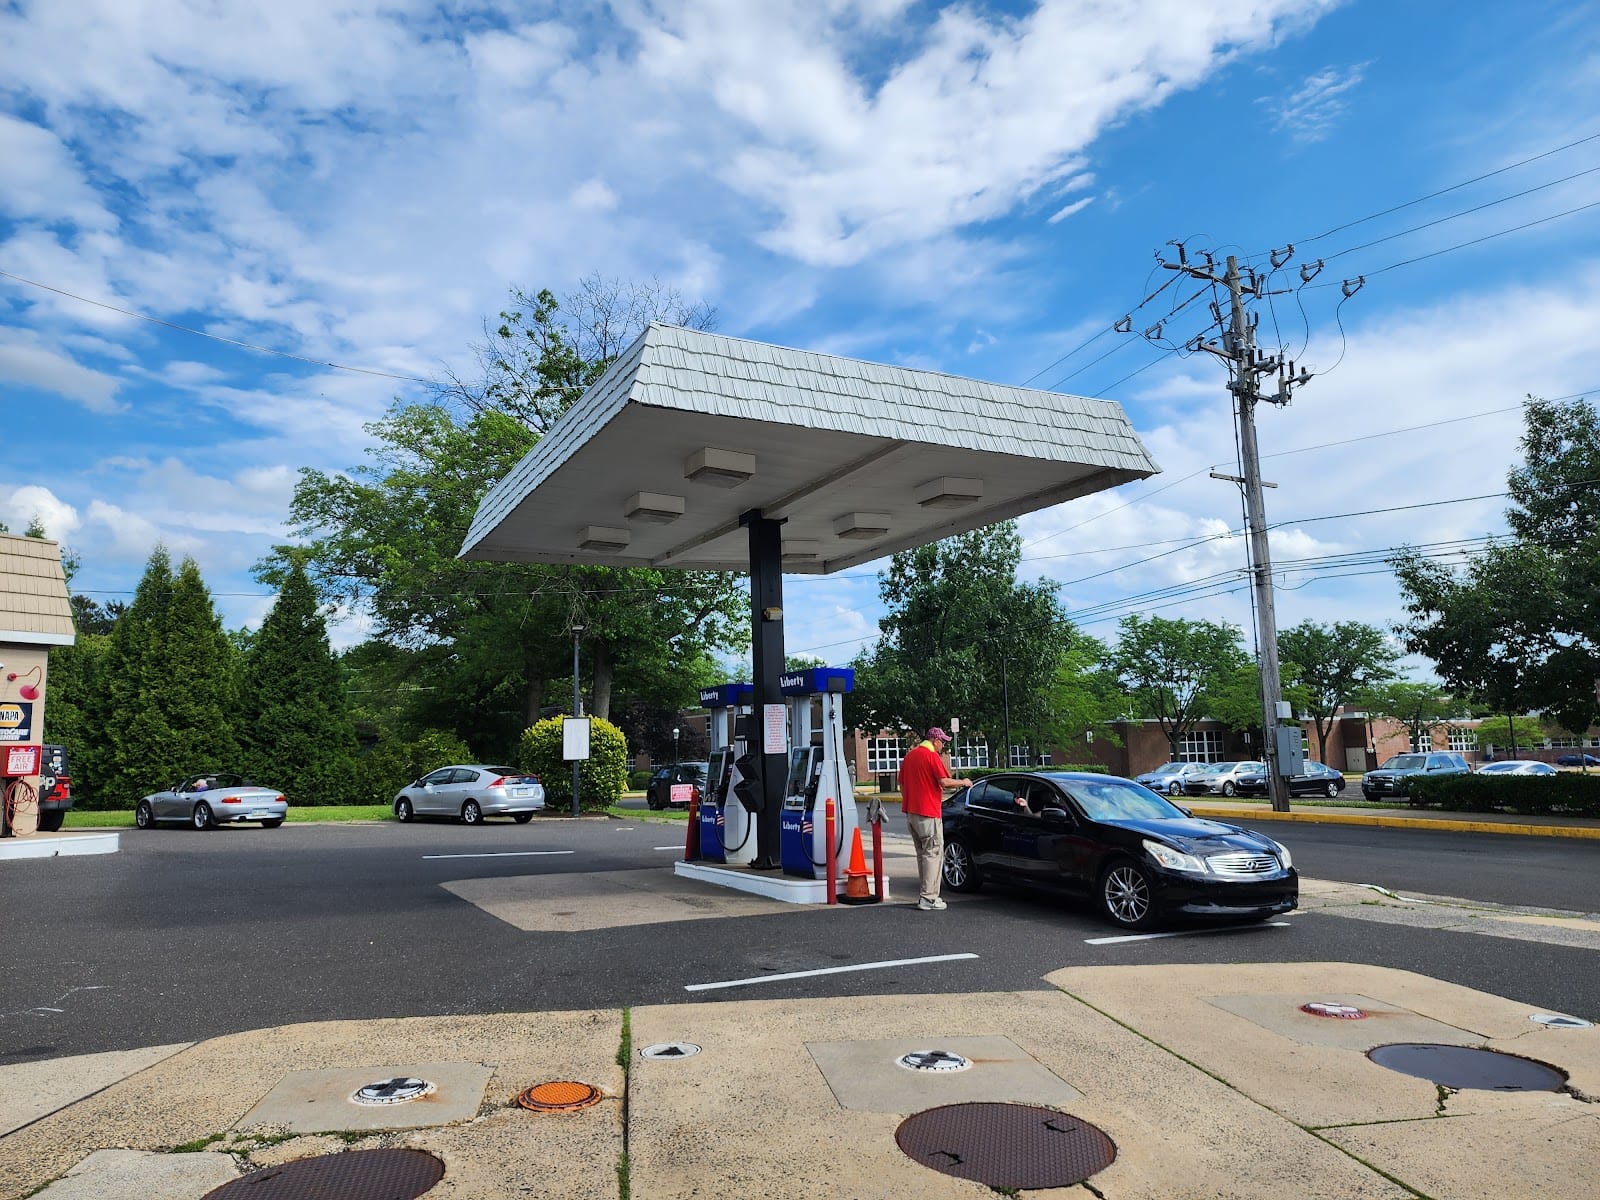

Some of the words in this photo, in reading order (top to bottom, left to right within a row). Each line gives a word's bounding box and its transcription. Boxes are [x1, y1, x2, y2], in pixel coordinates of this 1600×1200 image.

[780, 676, 804, 688] Liberty
[700, 691, 719, 701] Liberty
[11, 755, 32, 763] FREE
[701, 815, 716, 825] Liberty
[782, 821, 801, 833] Liberty
